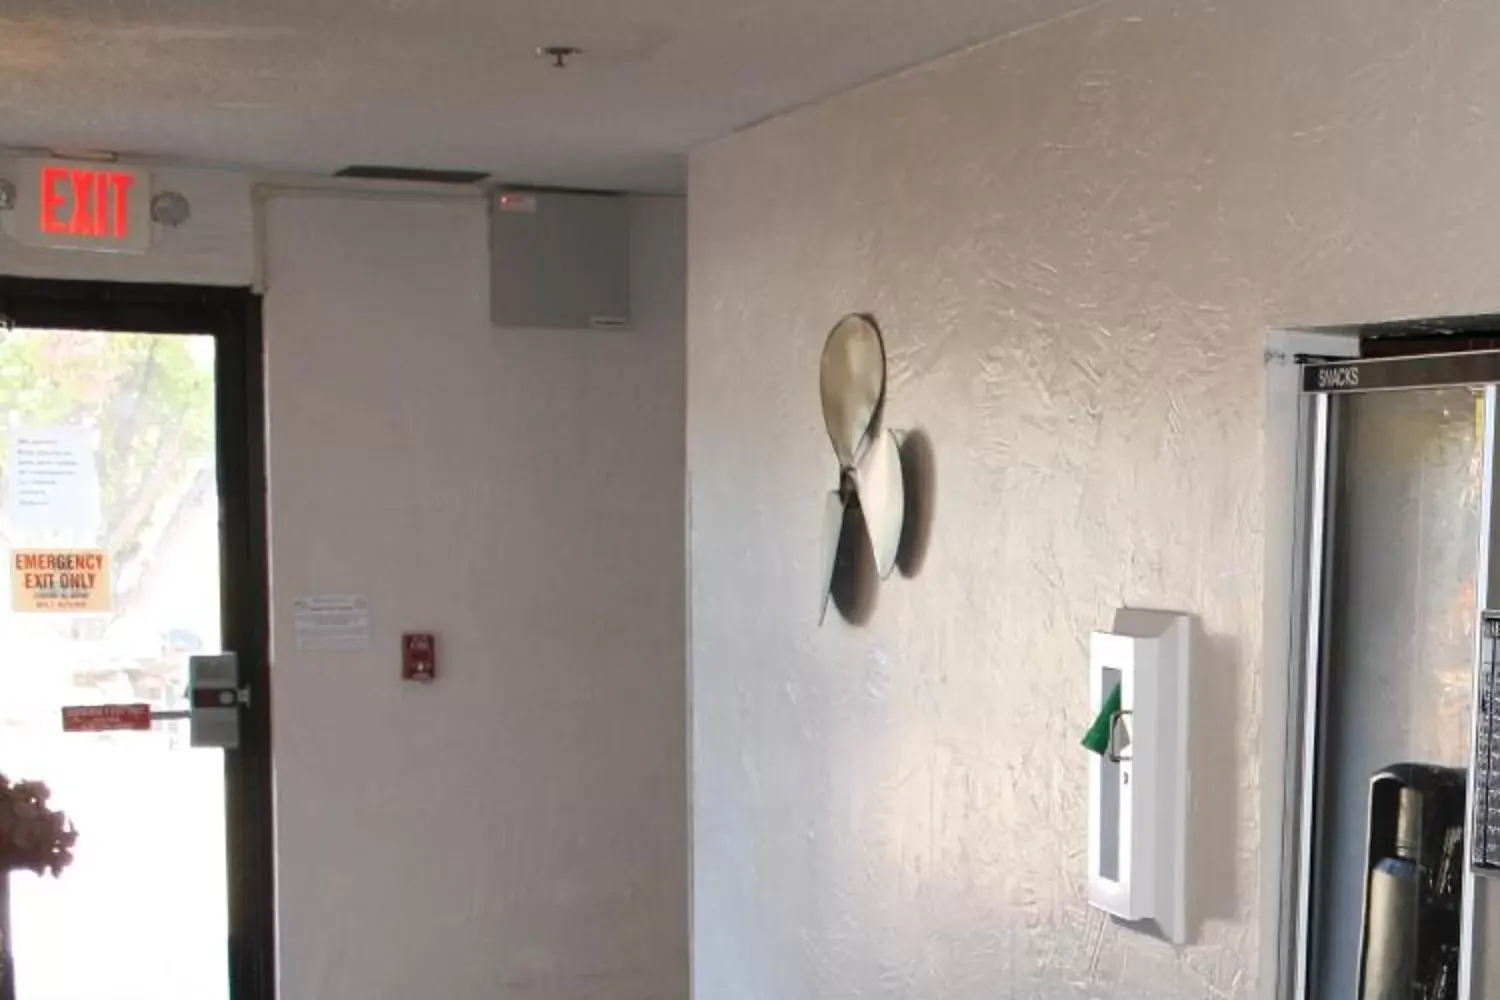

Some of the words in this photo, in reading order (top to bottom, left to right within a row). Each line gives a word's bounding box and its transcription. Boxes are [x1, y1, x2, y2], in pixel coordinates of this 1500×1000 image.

[40, 167, 134, 238] EXIT
[1318, 366, 1359, 388] SNACKS
[15, 553, 103, 570] EMERGENCY
[25, 572, 54, 589] EXIT
[59, 572, 96, 589] ONLY
